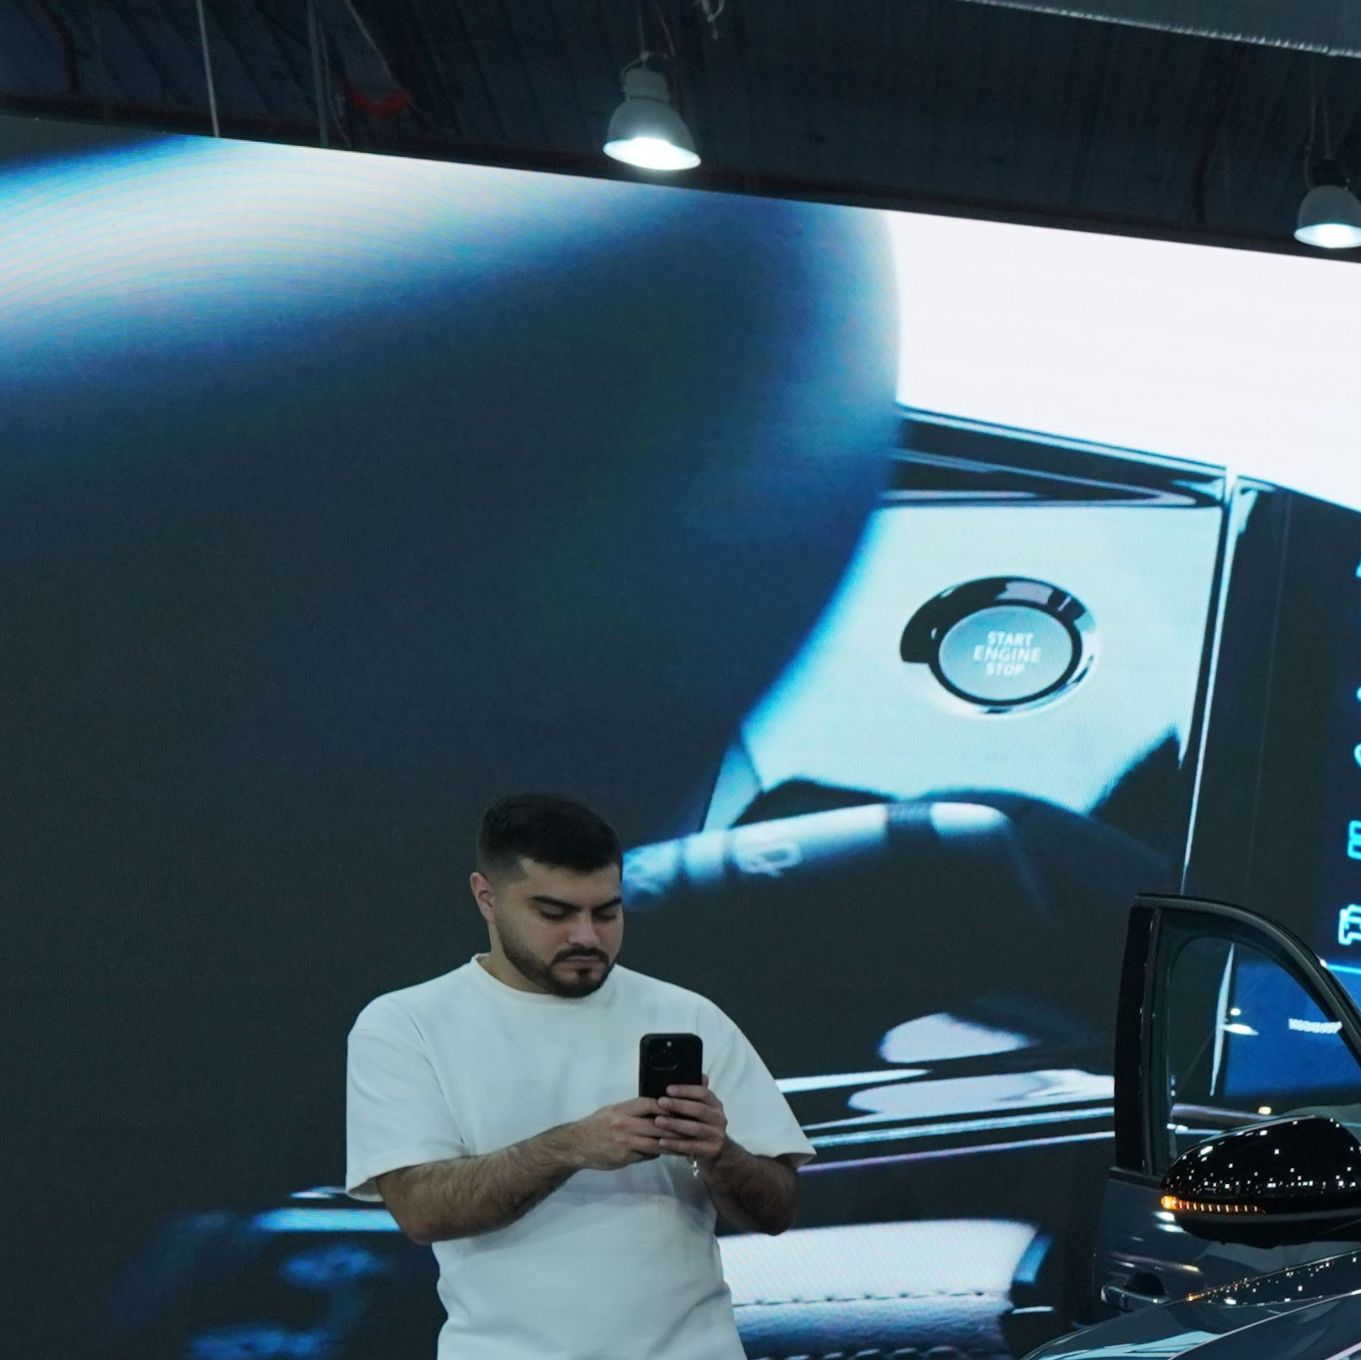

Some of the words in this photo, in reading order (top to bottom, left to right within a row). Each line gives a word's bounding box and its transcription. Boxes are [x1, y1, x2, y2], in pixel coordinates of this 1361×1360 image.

[987, 630, 1034, 647] START
[973, 645, 1040, 662] ENGINE
[985, 663, 1024, 677] STOP
